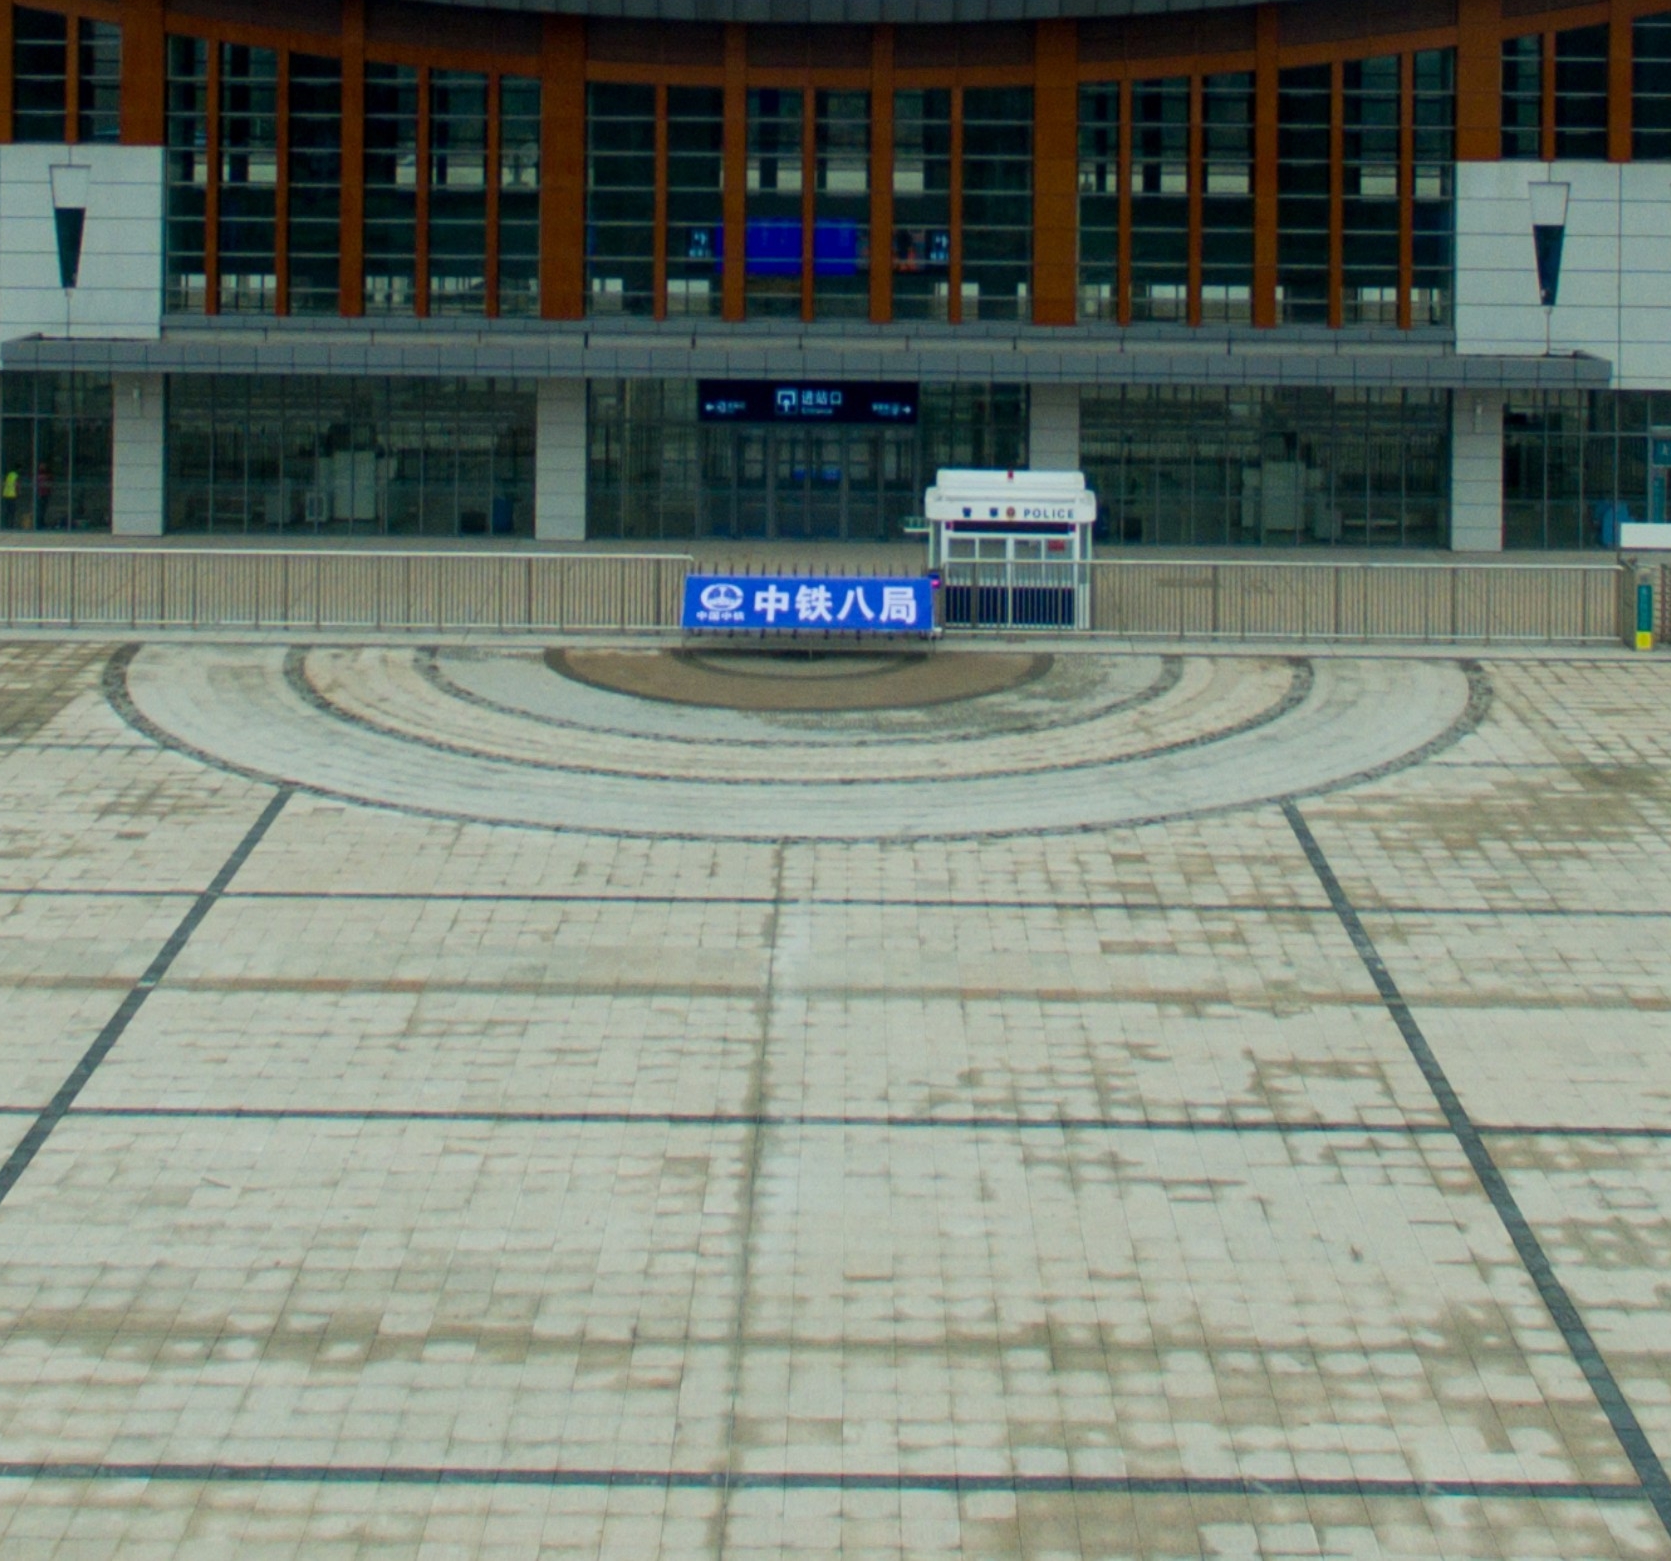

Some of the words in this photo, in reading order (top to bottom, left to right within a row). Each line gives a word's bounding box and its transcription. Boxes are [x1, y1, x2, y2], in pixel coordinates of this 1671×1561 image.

[801, 390, 842, 406] 进站口
[1023, 508, 1075, 519] POLICE
[753, 584, 918, 624] 中铁八局
